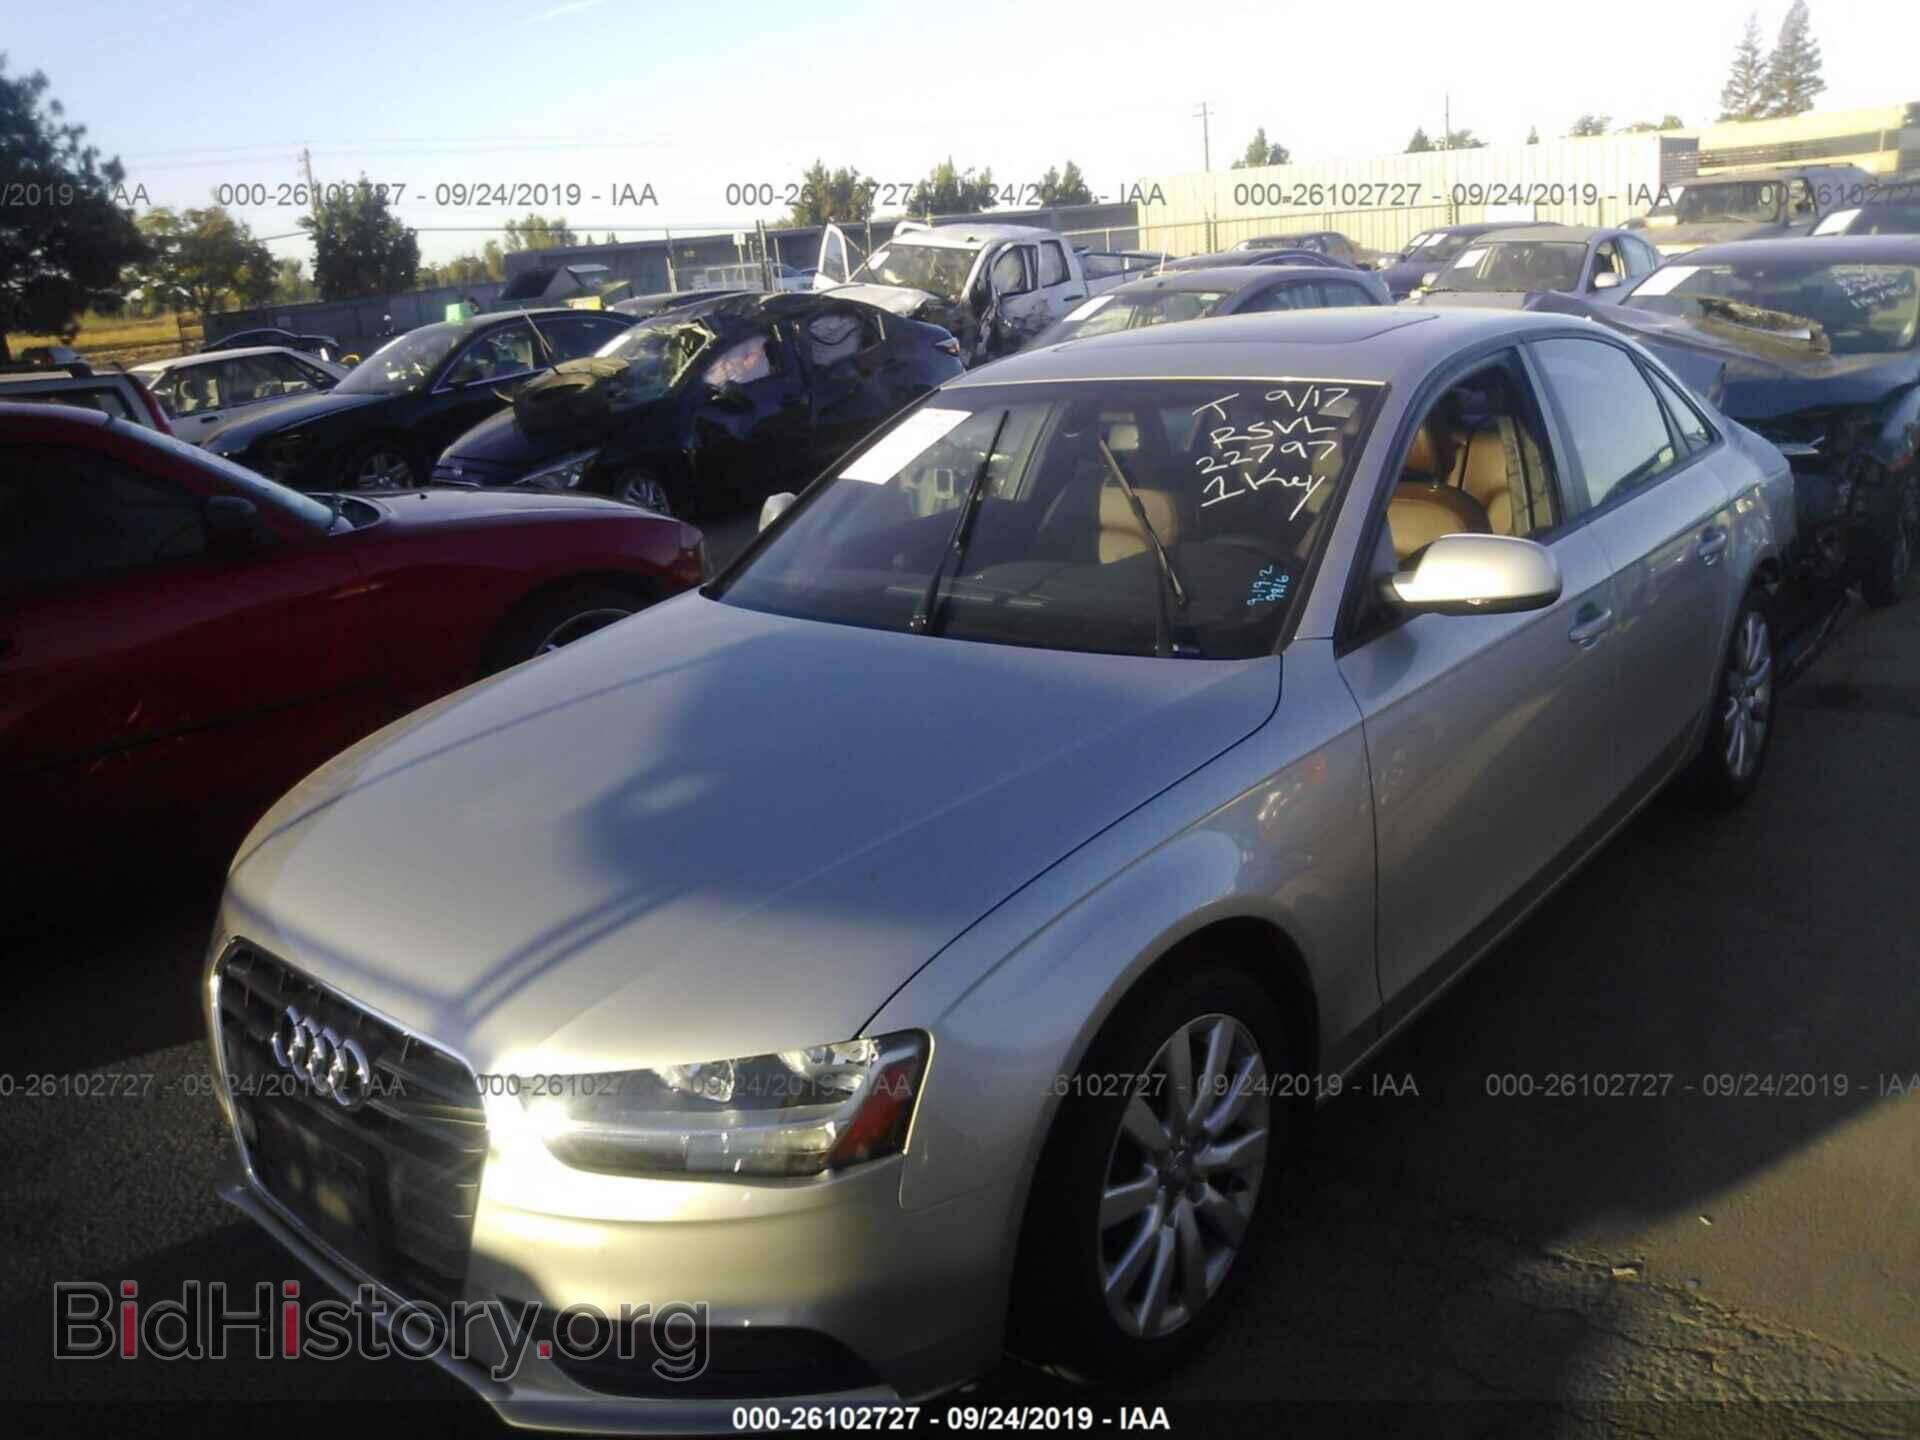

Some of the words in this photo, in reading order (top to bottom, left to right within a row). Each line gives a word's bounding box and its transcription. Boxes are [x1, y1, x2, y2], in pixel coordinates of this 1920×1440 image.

[1265, 385, 1349, 413] 9/17
[1196, 441, 1337, 475] 22797
[1201, 474, 1245, 508] 1
